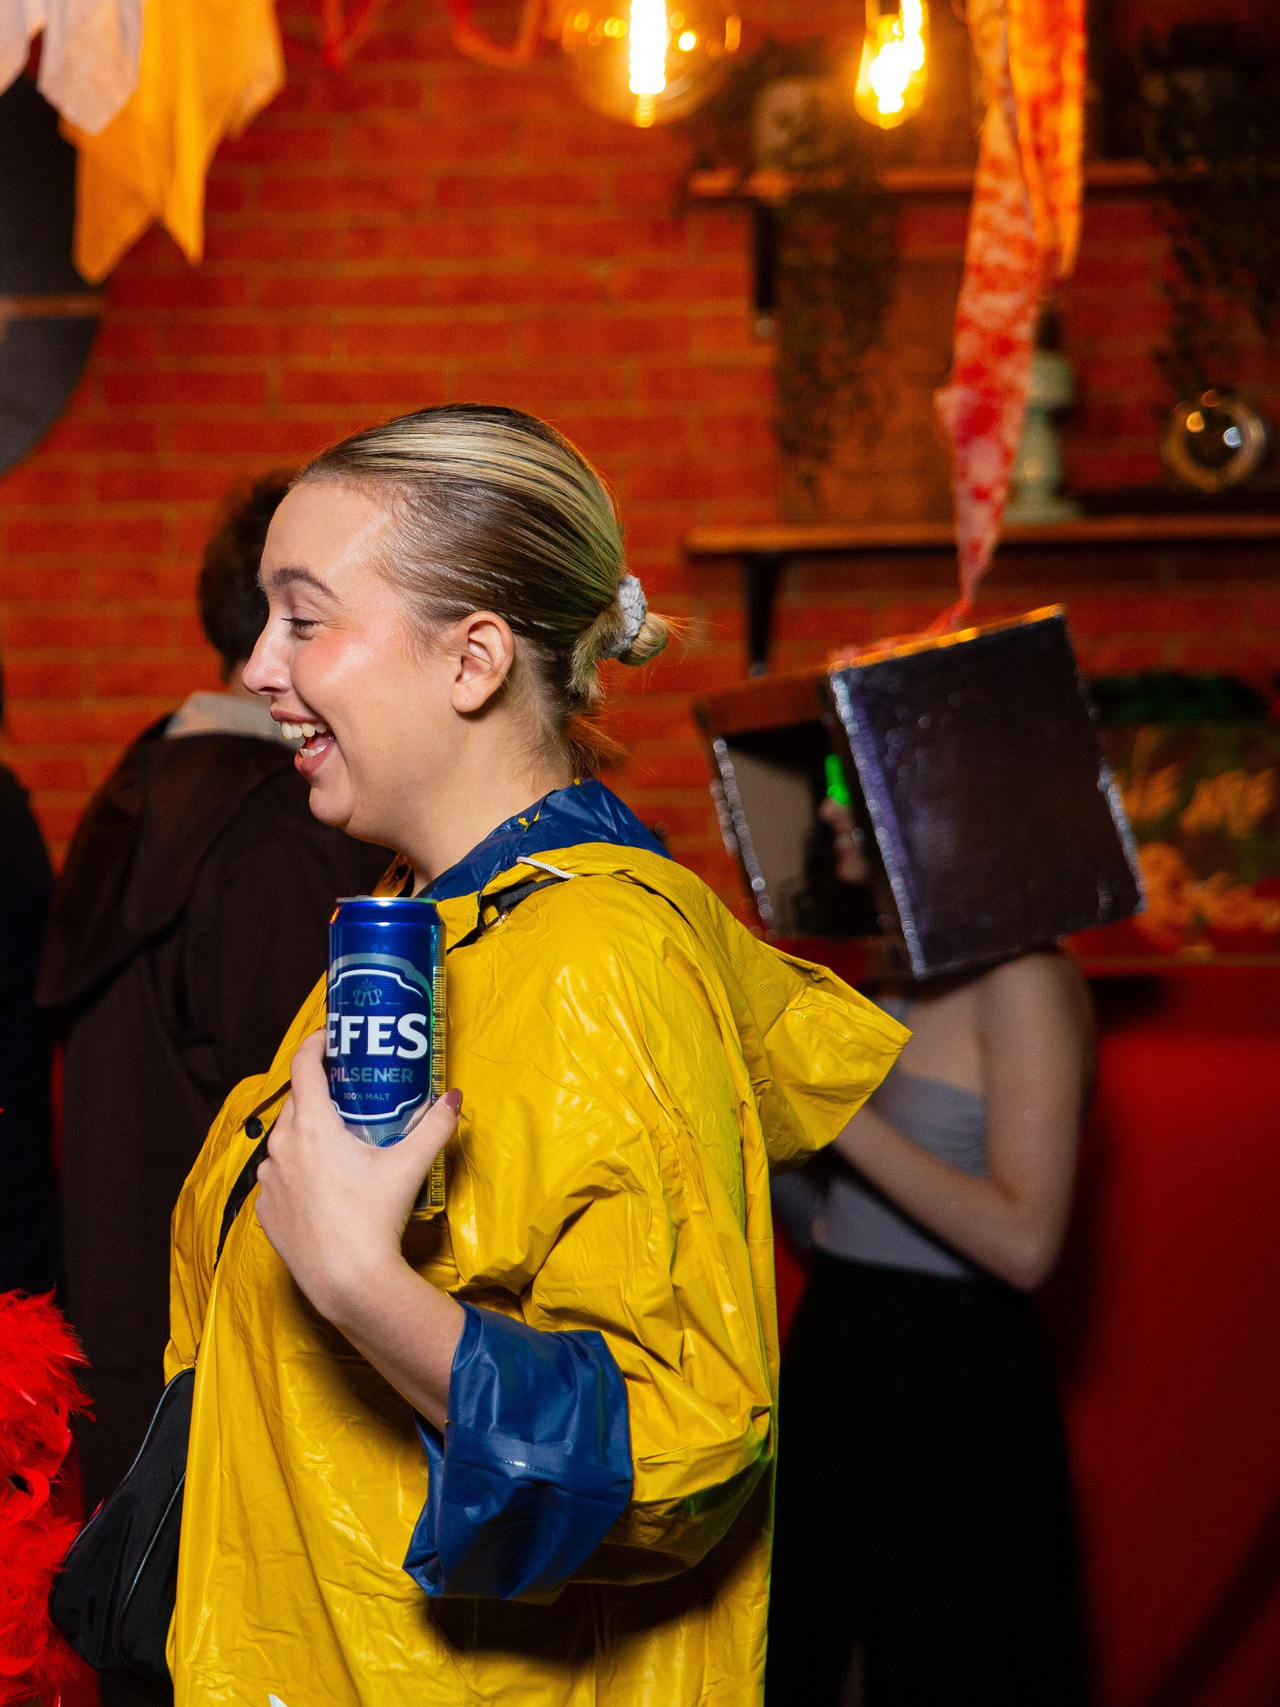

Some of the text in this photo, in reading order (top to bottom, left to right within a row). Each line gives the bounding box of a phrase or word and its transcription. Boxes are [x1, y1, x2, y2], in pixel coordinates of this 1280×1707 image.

[326, 1012, 428, 1059] EFES
[330, 1066, 413, 1083] PILSENER
[343, 1091, 391, 1101] 100% MALT
